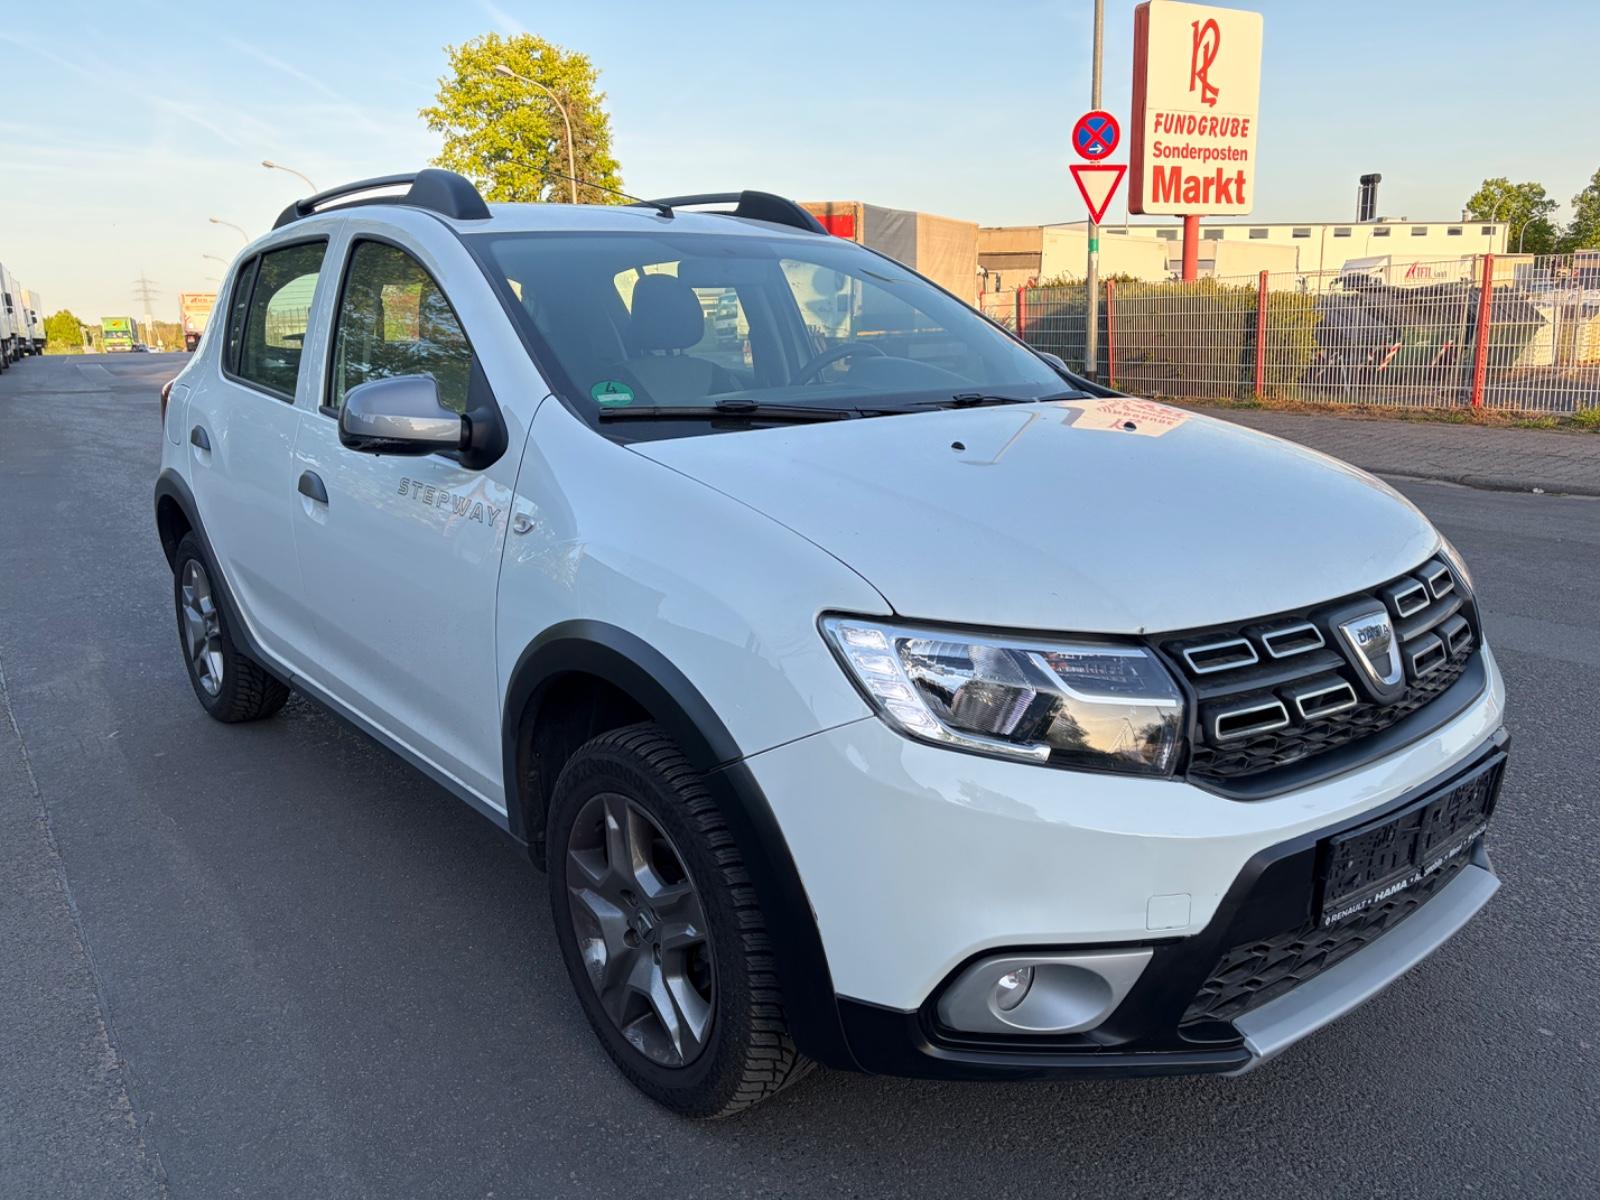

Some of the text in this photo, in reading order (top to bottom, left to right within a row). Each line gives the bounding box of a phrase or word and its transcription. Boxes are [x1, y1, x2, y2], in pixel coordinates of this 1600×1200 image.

[1154, 113, 1250, 138] FUNDGRUBE
[1153, 141, 1248, 163] Sonderposten
[1152, 165, 1246, 204] Markt
[397, 477, 501, 527] STEPWAY
[1331, 880, 1408, 923] RENAULT HAMA
